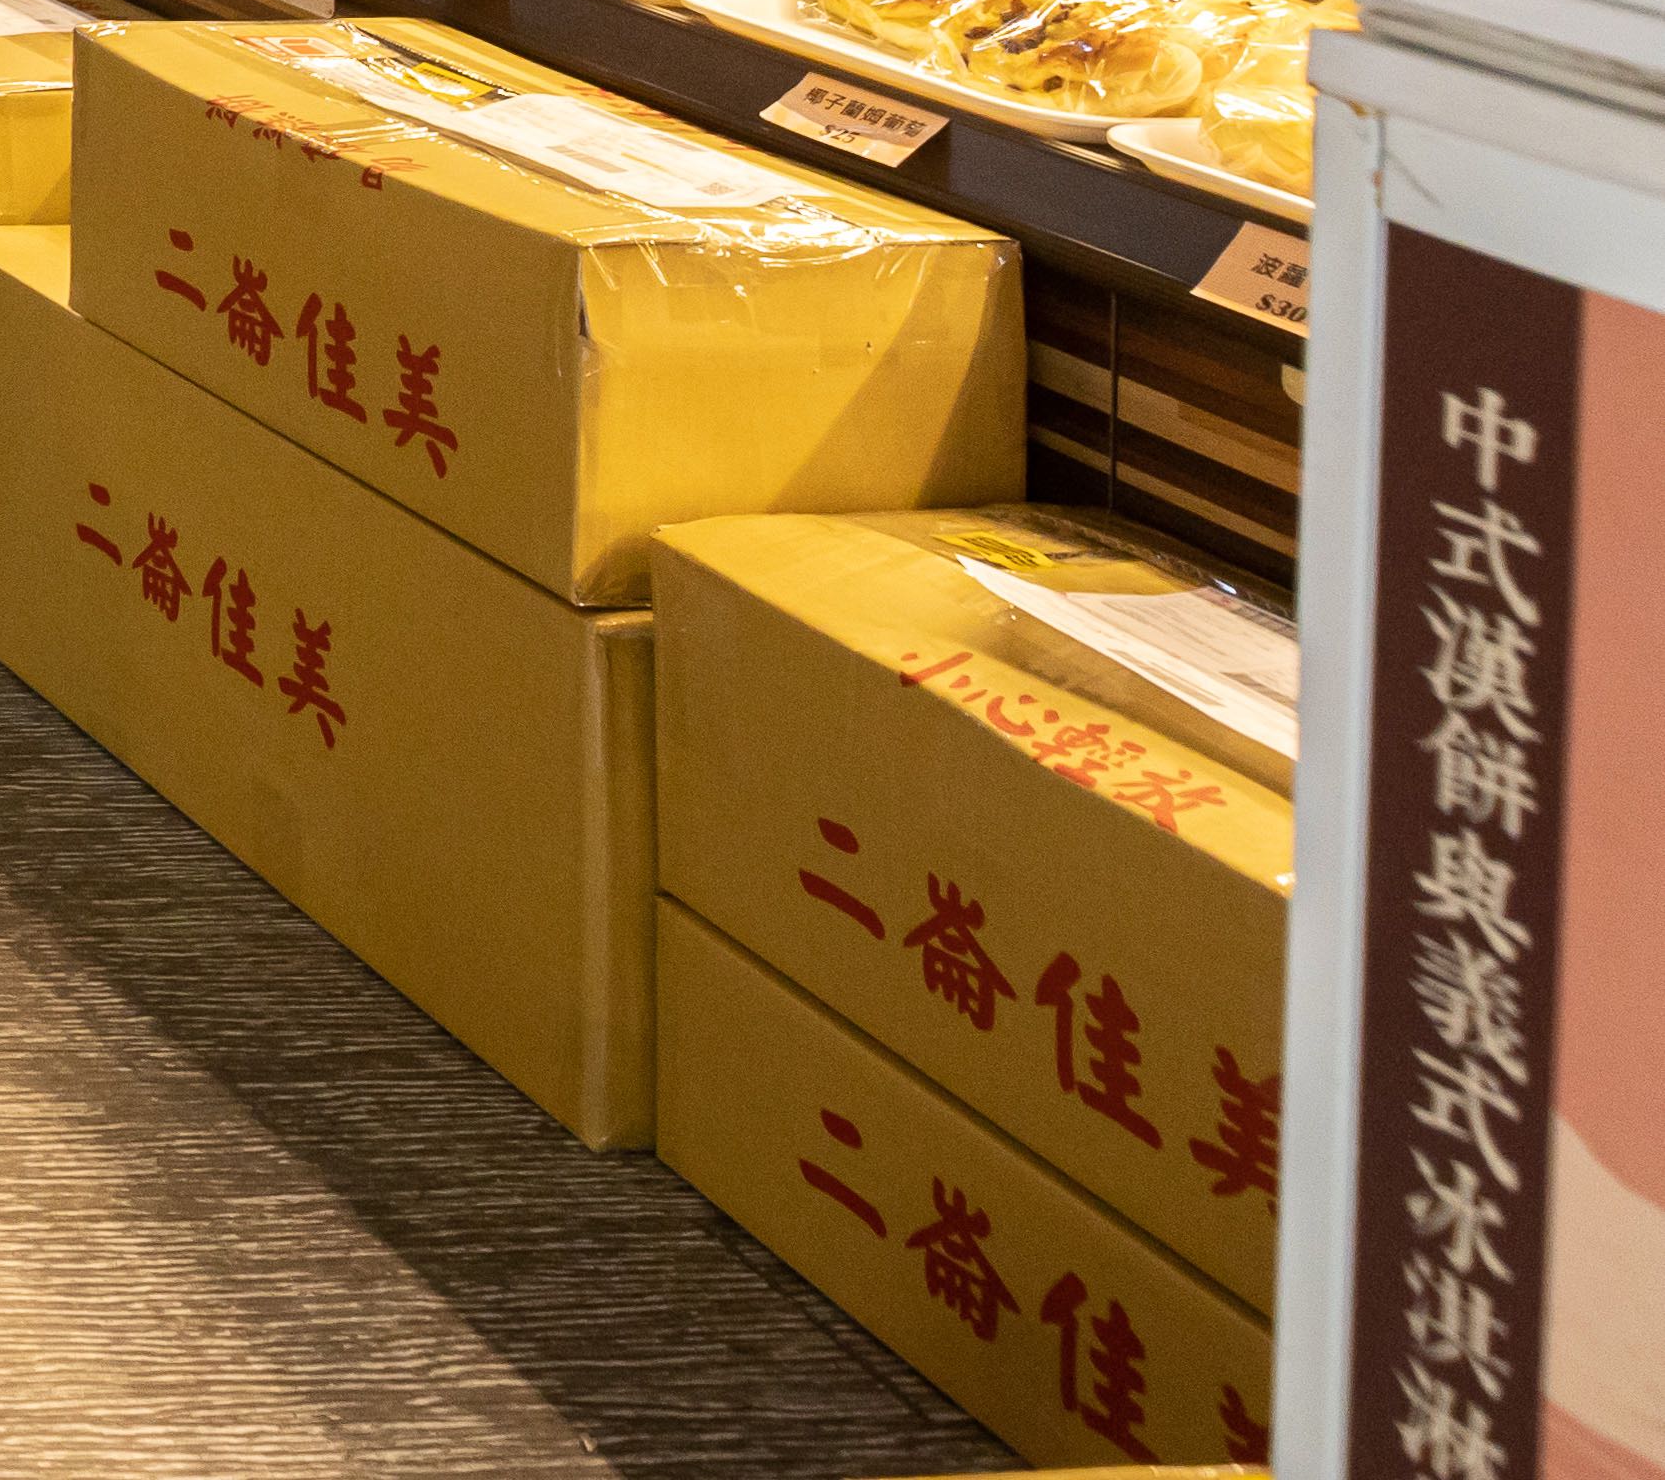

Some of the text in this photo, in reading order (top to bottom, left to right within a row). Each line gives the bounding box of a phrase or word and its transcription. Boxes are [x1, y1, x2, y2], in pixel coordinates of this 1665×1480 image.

[805, 85, 925, 140] 椰子蘭姆葡萄
[818, 121, 860, 146] $25
[155, 228, 459, 479] 二崙佳美
[1254, 292, 1306, 324] $30
[76, 482, 346, 750] 二崙佳美
[899, 648, 1229, 835] 小心輕放
